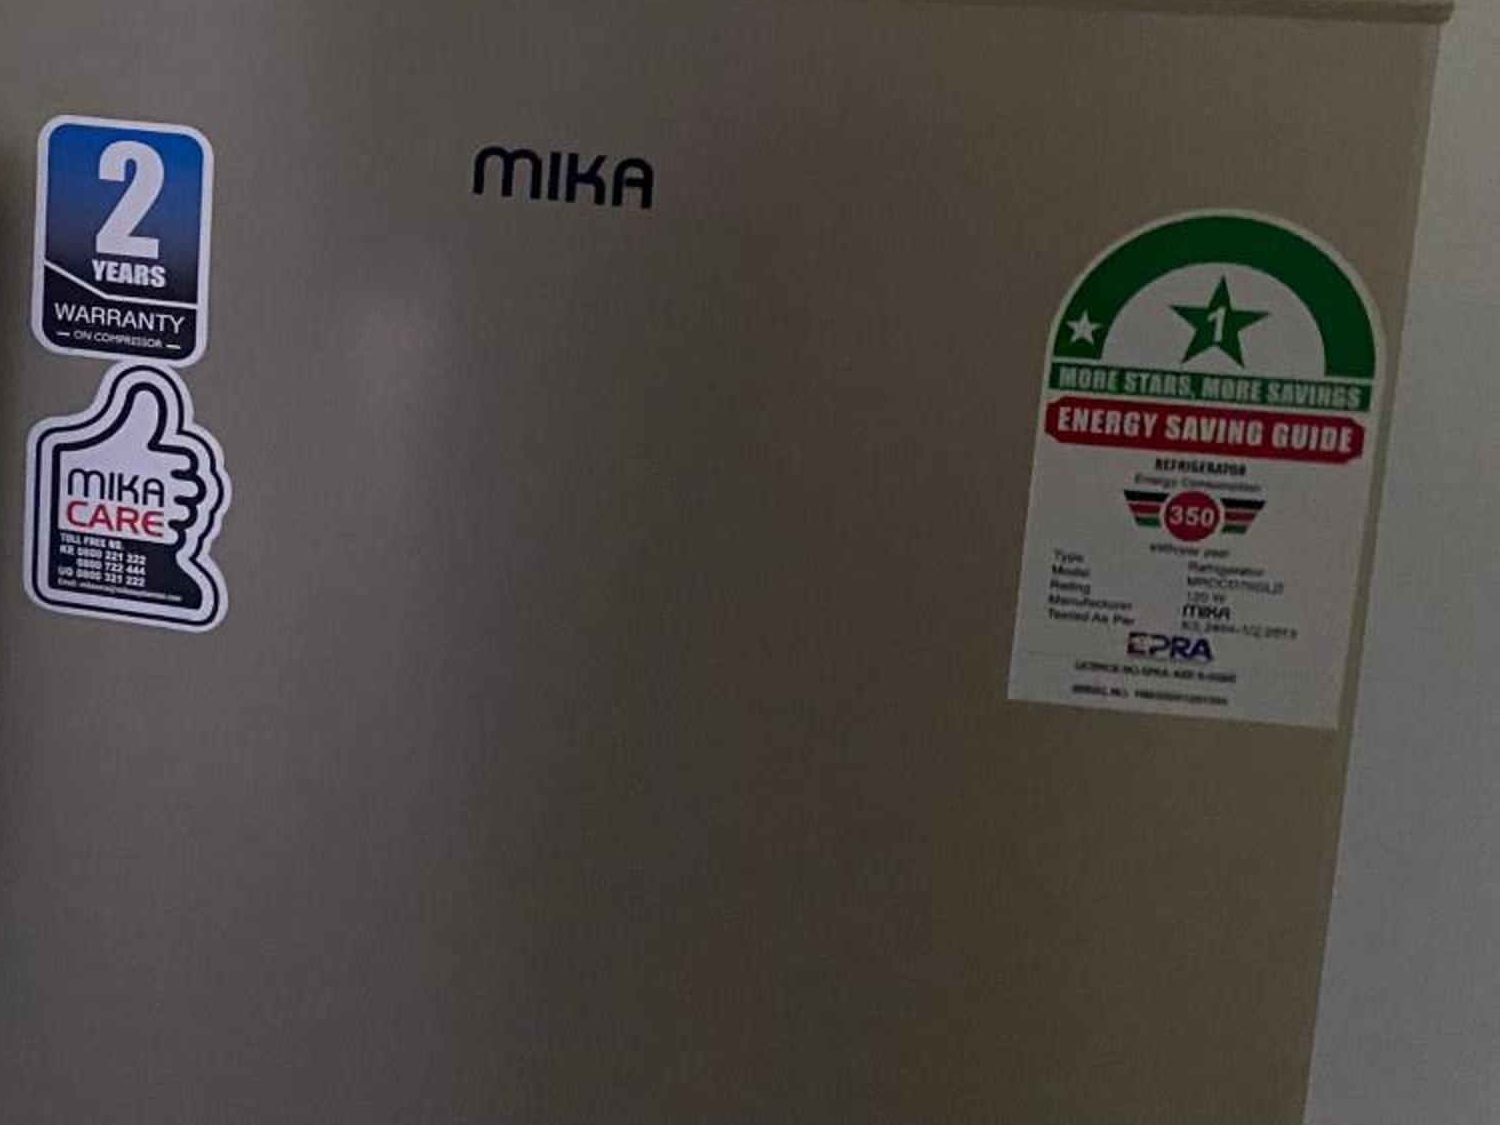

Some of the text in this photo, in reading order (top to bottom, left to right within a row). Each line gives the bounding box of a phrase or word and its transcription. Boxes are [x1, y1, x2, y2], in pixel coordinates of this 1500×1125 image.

[472, 145, 655, 210] MIKA
[95, 140, 165, 259] 2
[92, 259, 167, 288] YEARS
[54, 302, 185, 334] WARRANTY
[73, 330, 93, 341] ON
[1206, 306, 1228, 343] 1
[1058, 365, 1119, 392] MORE
[1201, 377, 1262, 404] MORE
[1267, 381, 1362, 409] SAVINGS
[1057, 405, 1353, 453] ENERGY SAVING GUIDE
[67, 468, 165, 508] MIKA
[66, 500, 165, 538] CARE
[1168, 504, 1215, 528] 350
[1126, 631, 1215, 662] EPRA
